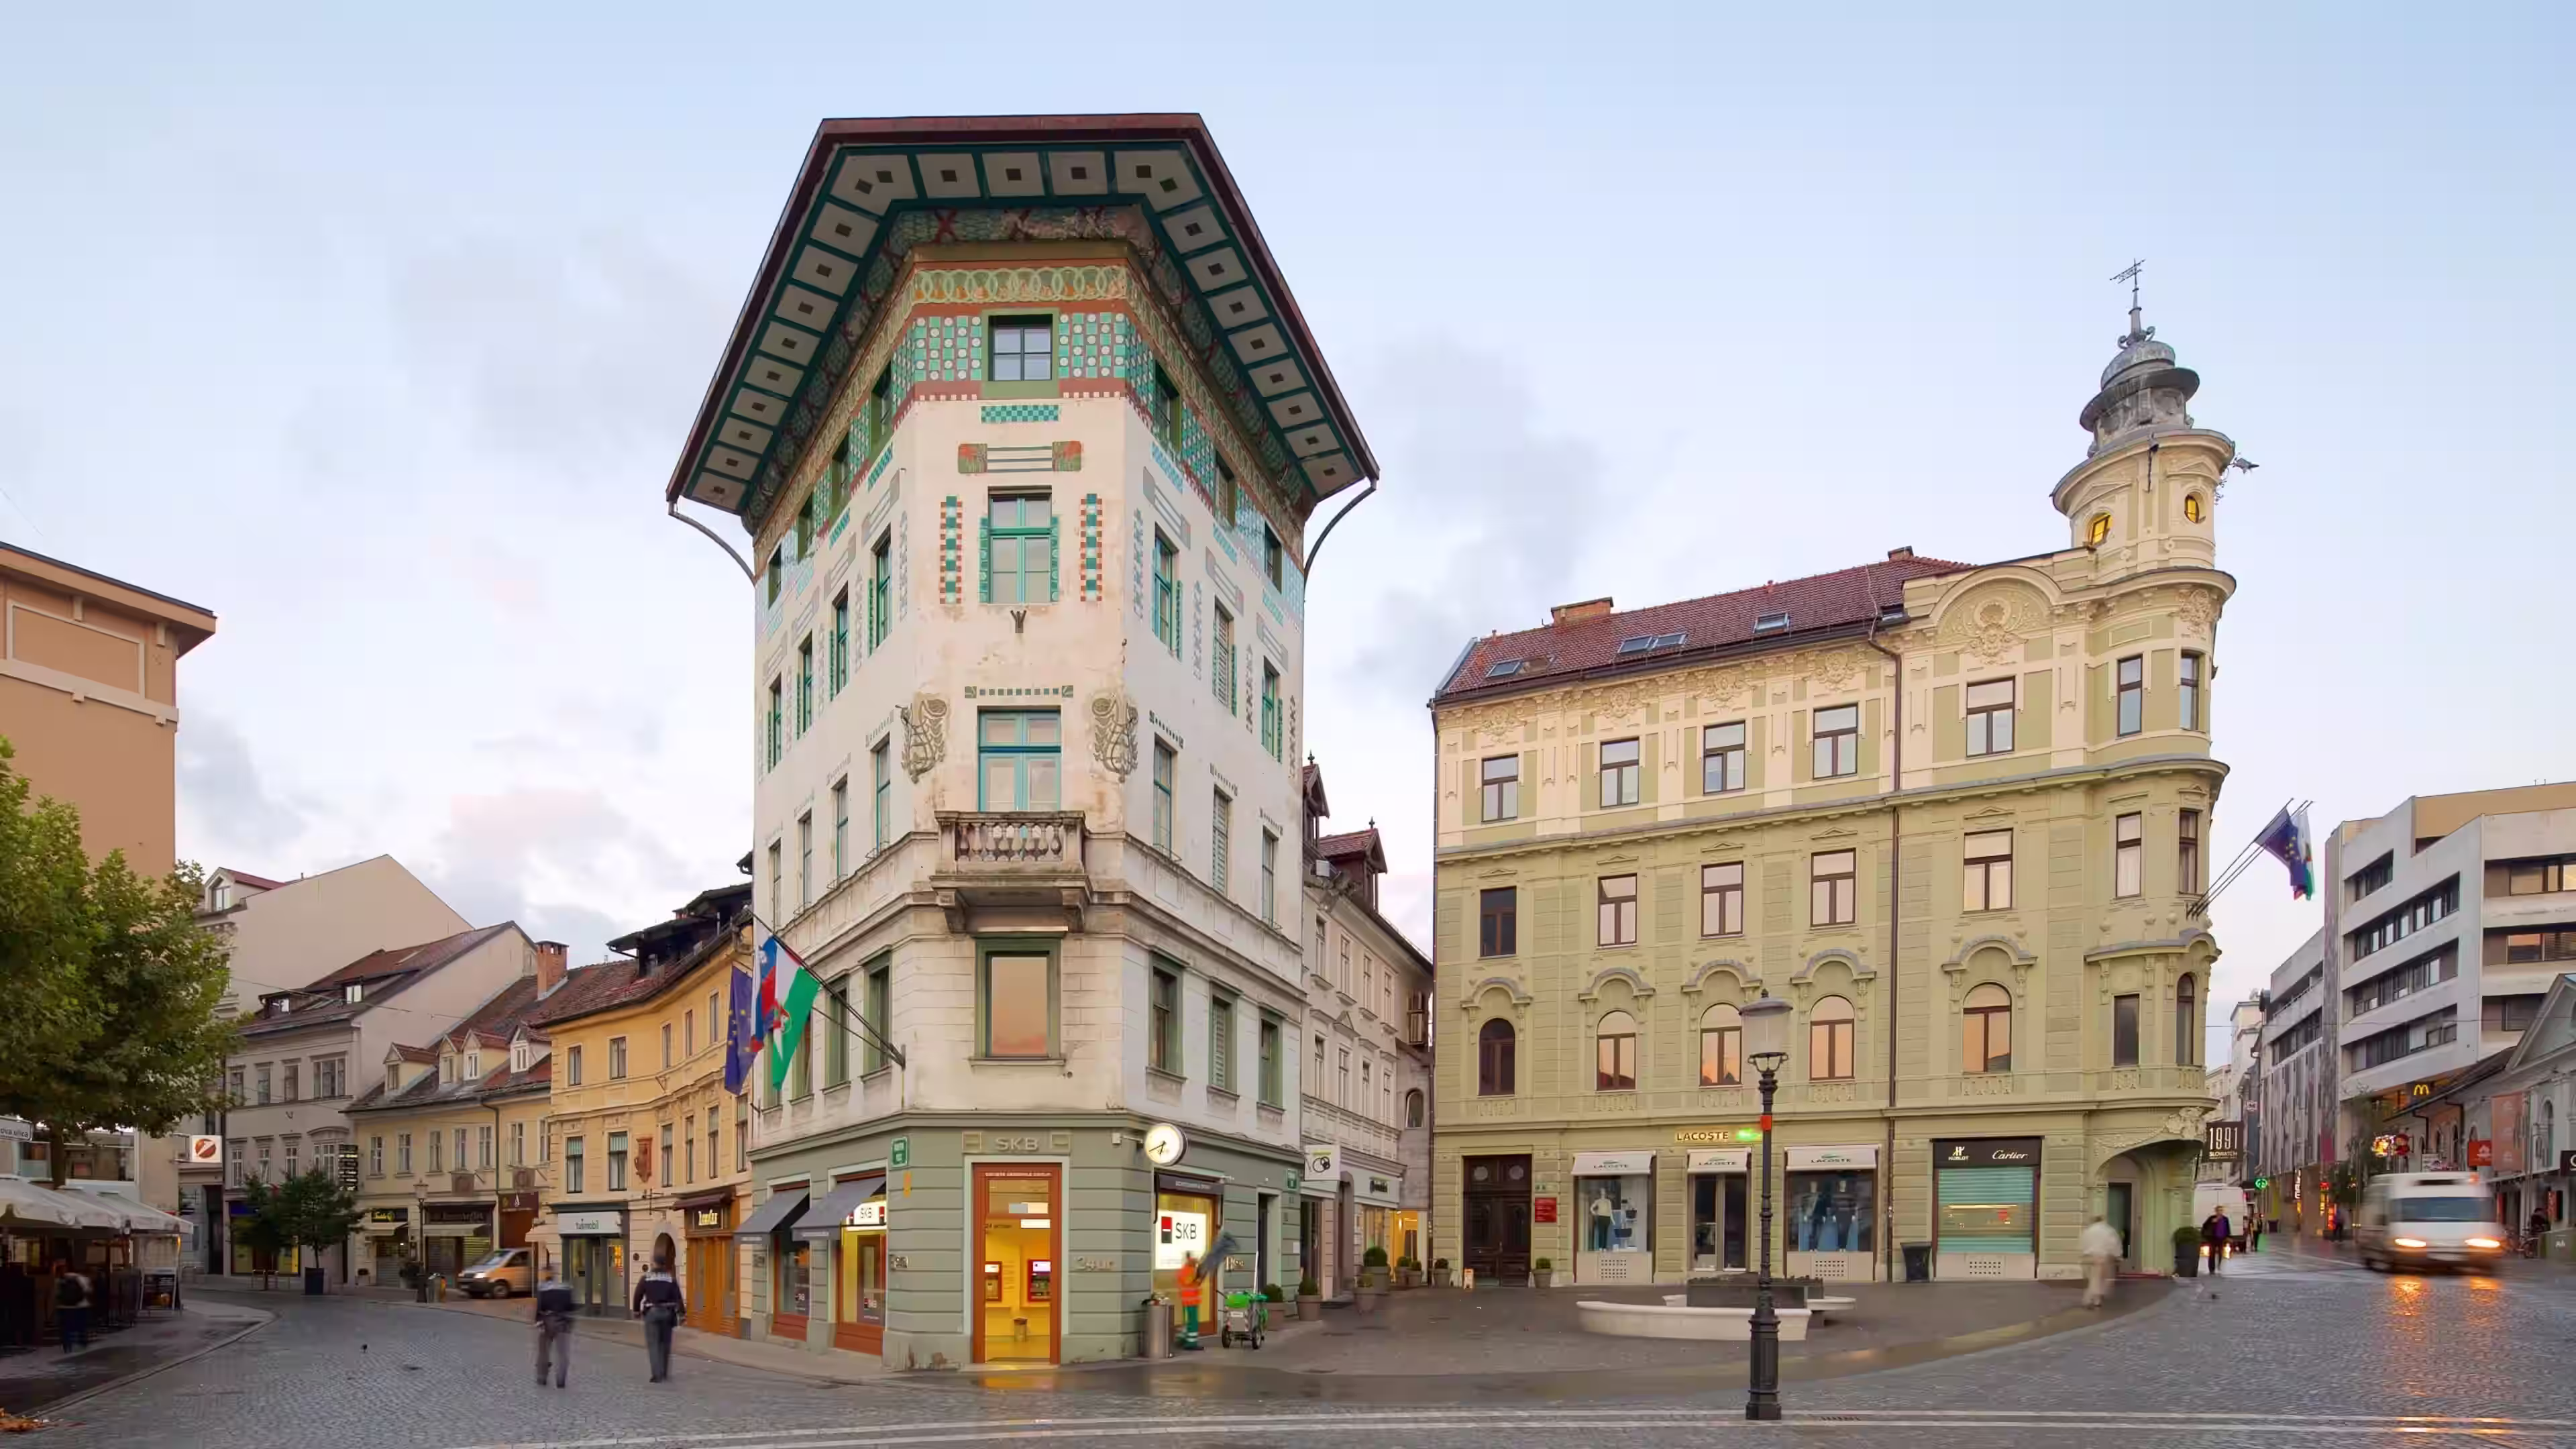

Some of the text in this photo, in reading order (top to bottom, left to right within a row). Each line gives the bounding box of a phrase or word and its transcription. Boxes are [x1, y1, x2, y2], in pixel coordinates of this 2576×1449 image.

[1677, 1131, 1729, 1141] LACOSTE
[2210, 1127, 2238, 1150] 1991
[996, 1137, 1038, 1152] SKB
[1992, 1149, 2028, 1160] Cartier
[860, 1207, 872, 1219] SKB
[1175, 1222, 1197, 1240] SKB
